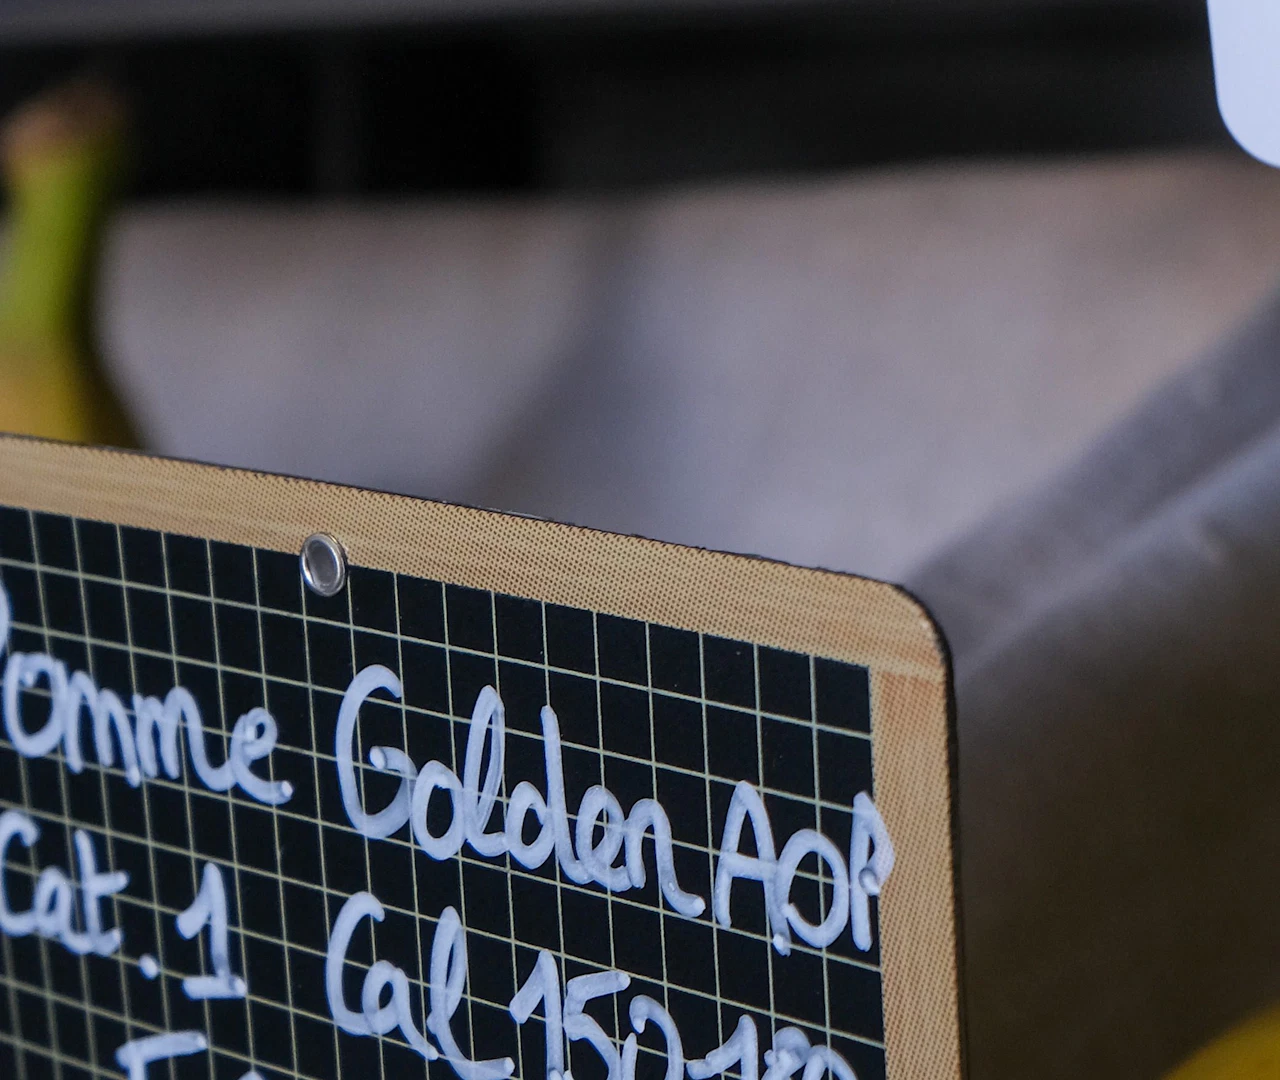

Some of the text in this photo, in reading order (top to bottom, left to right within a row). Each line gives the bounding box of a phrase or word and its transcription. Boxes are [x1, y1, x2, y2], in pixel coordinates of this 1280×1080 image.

[0, 582, 895, 956] omme Golden AOP
[176, 862, 248, 1000] 1
[326, 890, 515, 1079] Cal
